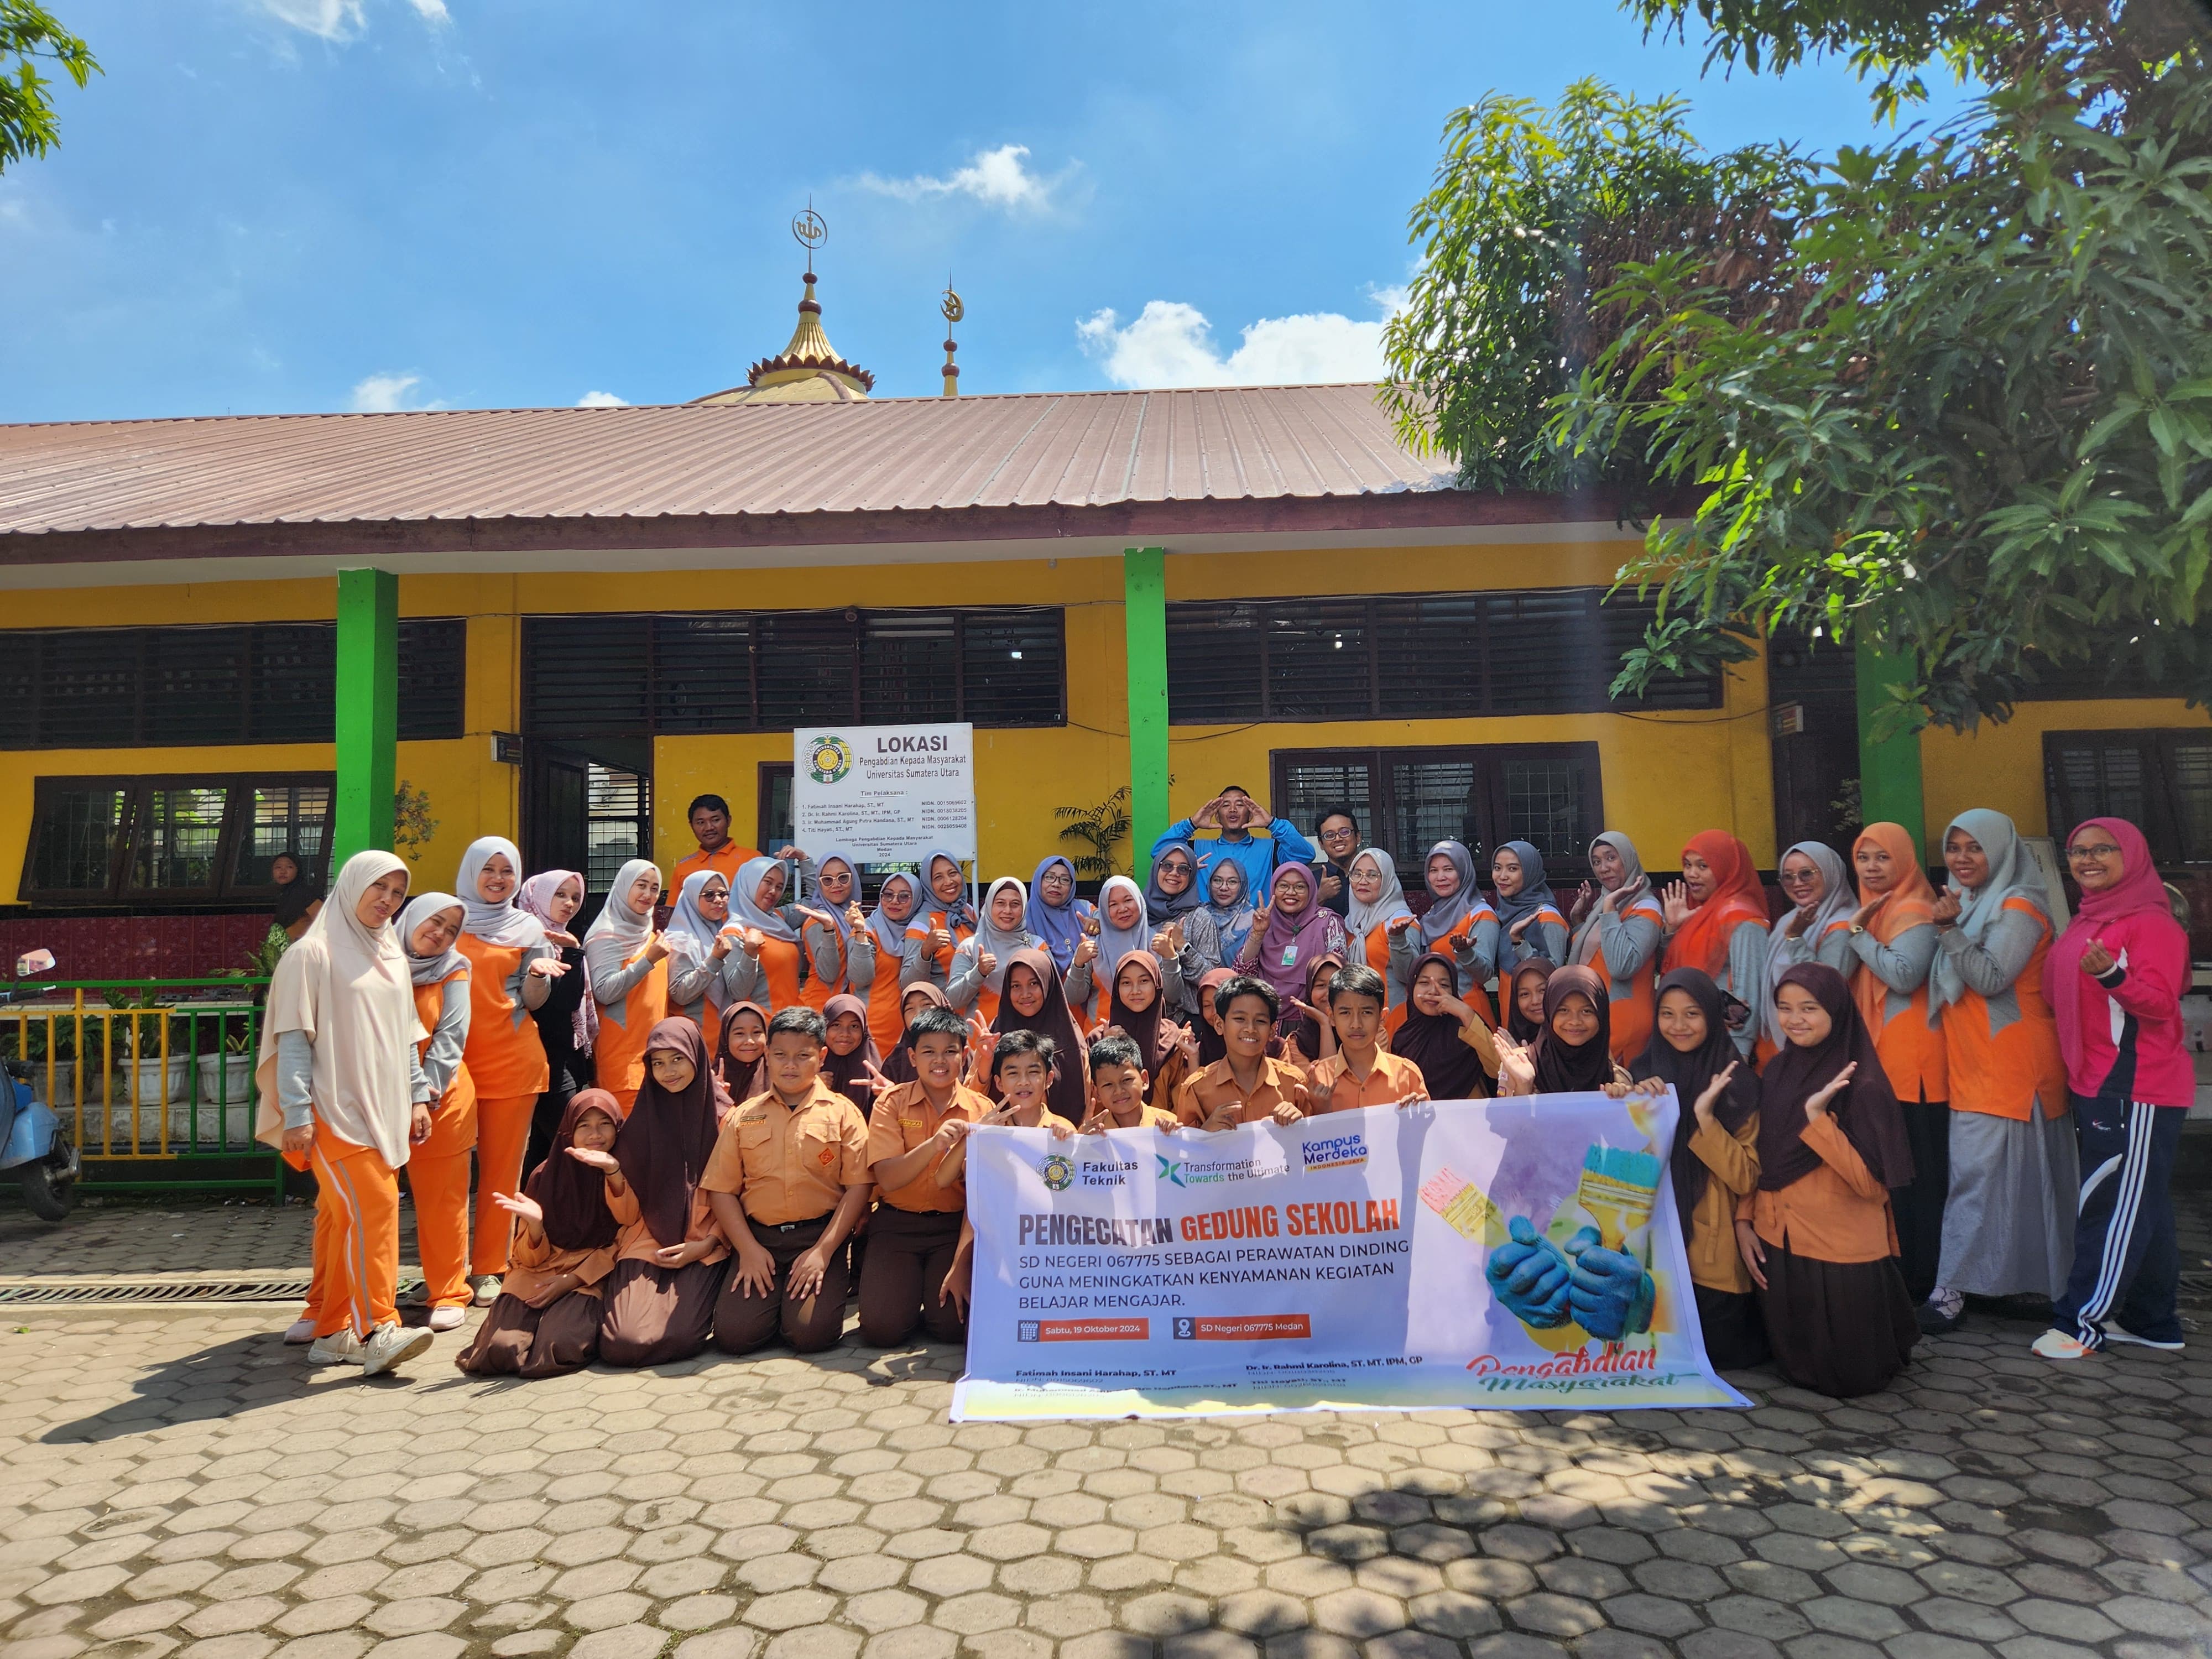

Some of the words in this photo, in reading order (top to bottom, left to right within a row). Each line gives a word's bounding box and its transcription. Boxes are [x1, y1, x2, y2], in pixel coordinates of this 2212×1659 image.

[815, 745, 841, 755] UNIVERSITAS
[877, 735, 947, 753] LOKASI
[859, 757, 898, 768] Pengabdian
[900, 755, 925, 766] Kepada
[927, 754, 966, 765] Masyarakat
[867, 769, 904, 779] Universitas
[906, 769, 938, 778] Sumatera
[941, 768, 959, 776] Utara
[1302, 1134, 1361, 1154] Kampus
[1303, 1145, 1368, 1165] Merdeka
[1083, 1161, 1138, 1172] Fakultas
[1184, 1159, 1261, 1172] Transformation
[1310, 1161, 1345, 1171] INDONESIA
[1082, 1175, 1126, 1186] Teknik
[1184, 1172, 1225, 1183] Towards
[1228, 1171, 1244, 1181] the
[1248, 1164, 1290, 1178] Ultimate
[1019, 1214, 1173, 1248] PENGECATAN
[1180, 1204, 1279, 1242] GEDUNG
[1286, 1198, 1400, 1236] SEKOLAH
[1019, 1256, 1040, 1268] SD
[1045, 1255, 1102, 1268] NEGERI
[1107, 1254, 1160, 1267] 067775
[1165, 1250, 1230, 1265] SEBAGAI
[1236, 1246, 1334, 1262] PERAWATAN
[1340, 1240, 1409, 1258] DINDING
[1019, 1276, 1064, 1288] GUNA
[1070, 1272, 1194, 1288] MENINGKATKAN
[1200, 1267, 1311, 1285] KENYAMANAN
[1316, 1262, 1394, 1280] KEGIATAN
[1019, 1296, 1088, 1308] BELAJAR
[1094, 1294, 1185, 1307] MENGAJAR.
[1046, 1327, 1072, 1335] Sabtu,
[1084, 1325, 1119, 1333] Oktober
[1215, 1324, 1242, 1334] Negeri
[1244, 1323, 1274, 1332] 067775
[1351, 1360, 1365, 1368] ST.
[1366, 1358, 1384, 1366] MT.
[1386, 1357, 1407, 1366] IPM,
[1465, 1341, 1657, 1379] Pengabdian
[1479, 1373, 1703, 1394] Masyarakat
